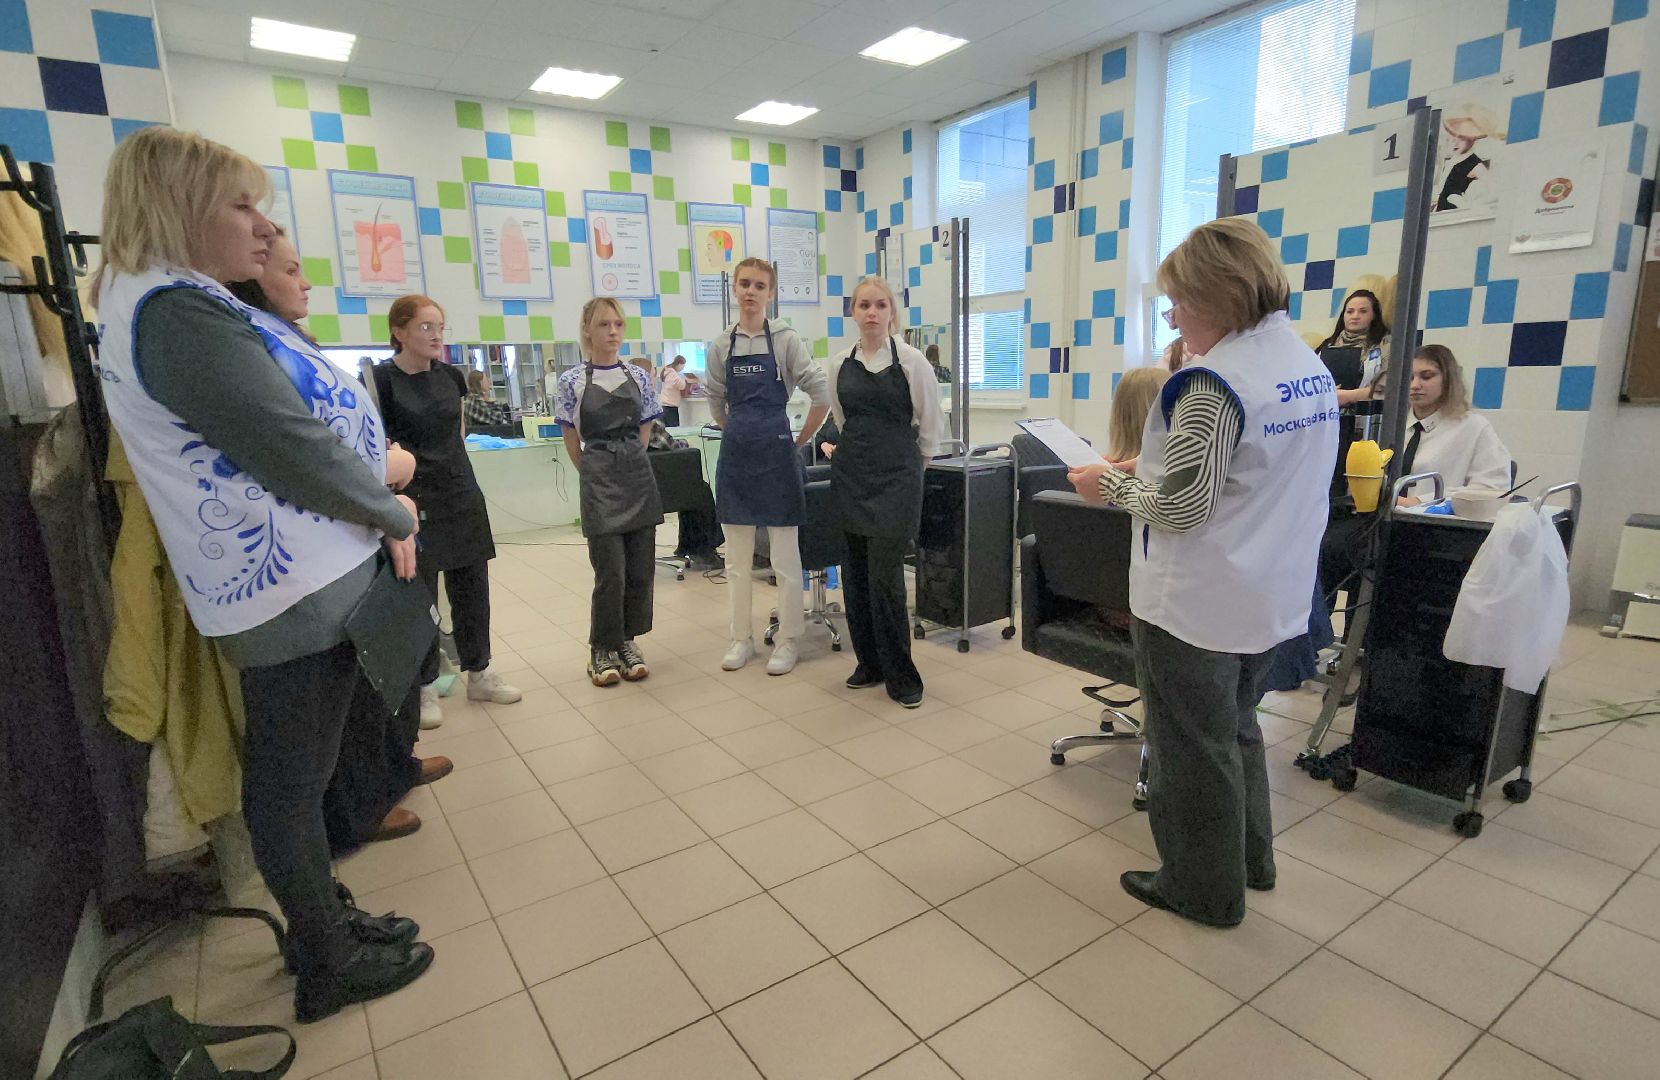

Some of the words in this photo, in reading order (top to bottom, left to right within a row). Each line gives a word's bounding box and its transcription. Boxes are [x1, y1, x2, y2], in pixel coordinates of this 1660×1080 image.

[1383, 133, 1400, 161] 1
[942, 231, 949, 247] 2
[732, 364, 766, 374] ESTEL
